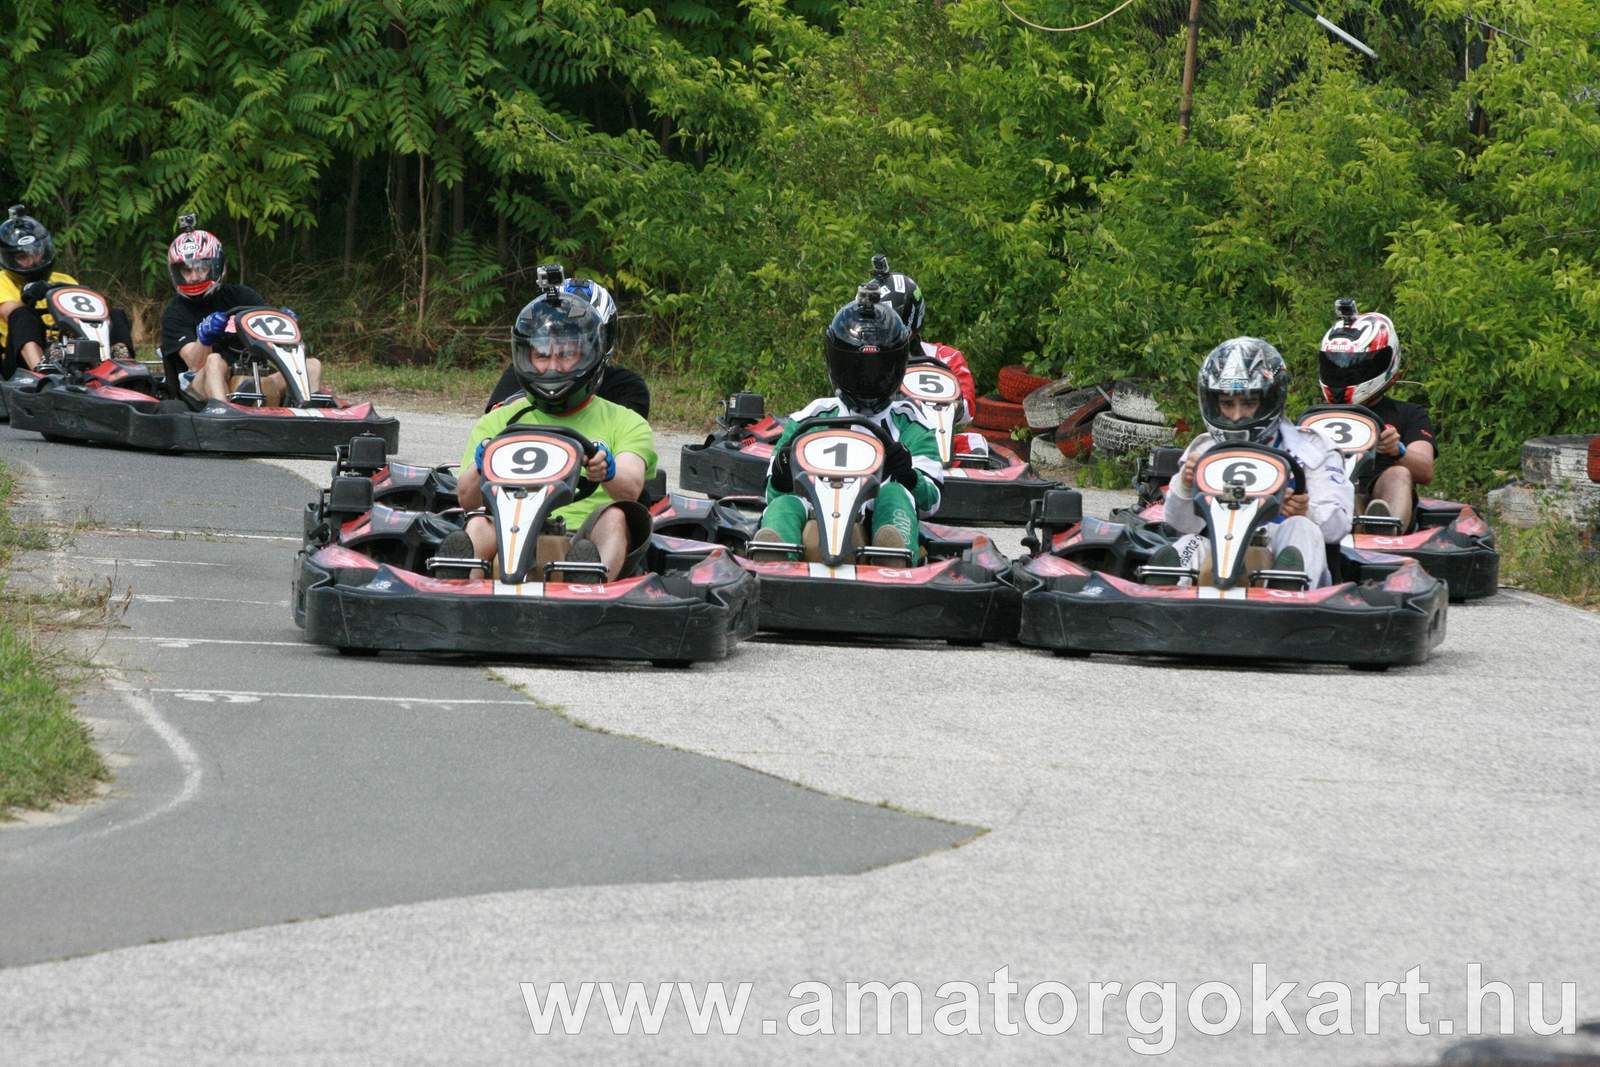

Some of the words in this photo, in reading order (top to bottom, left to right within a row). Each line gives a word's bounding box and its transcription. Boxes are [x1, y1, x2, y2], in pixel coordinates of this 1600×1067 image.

[71, 295, 96, 312] 8
[250, 316, 295, 336] 12
[918, 374, 945, 394] 5
[1324, 421, 1353, 444] 3
[510, 446, 549, 475] 9
[822, 442, 848, 468] 1
[1222, 461, 1258, 487] 6
